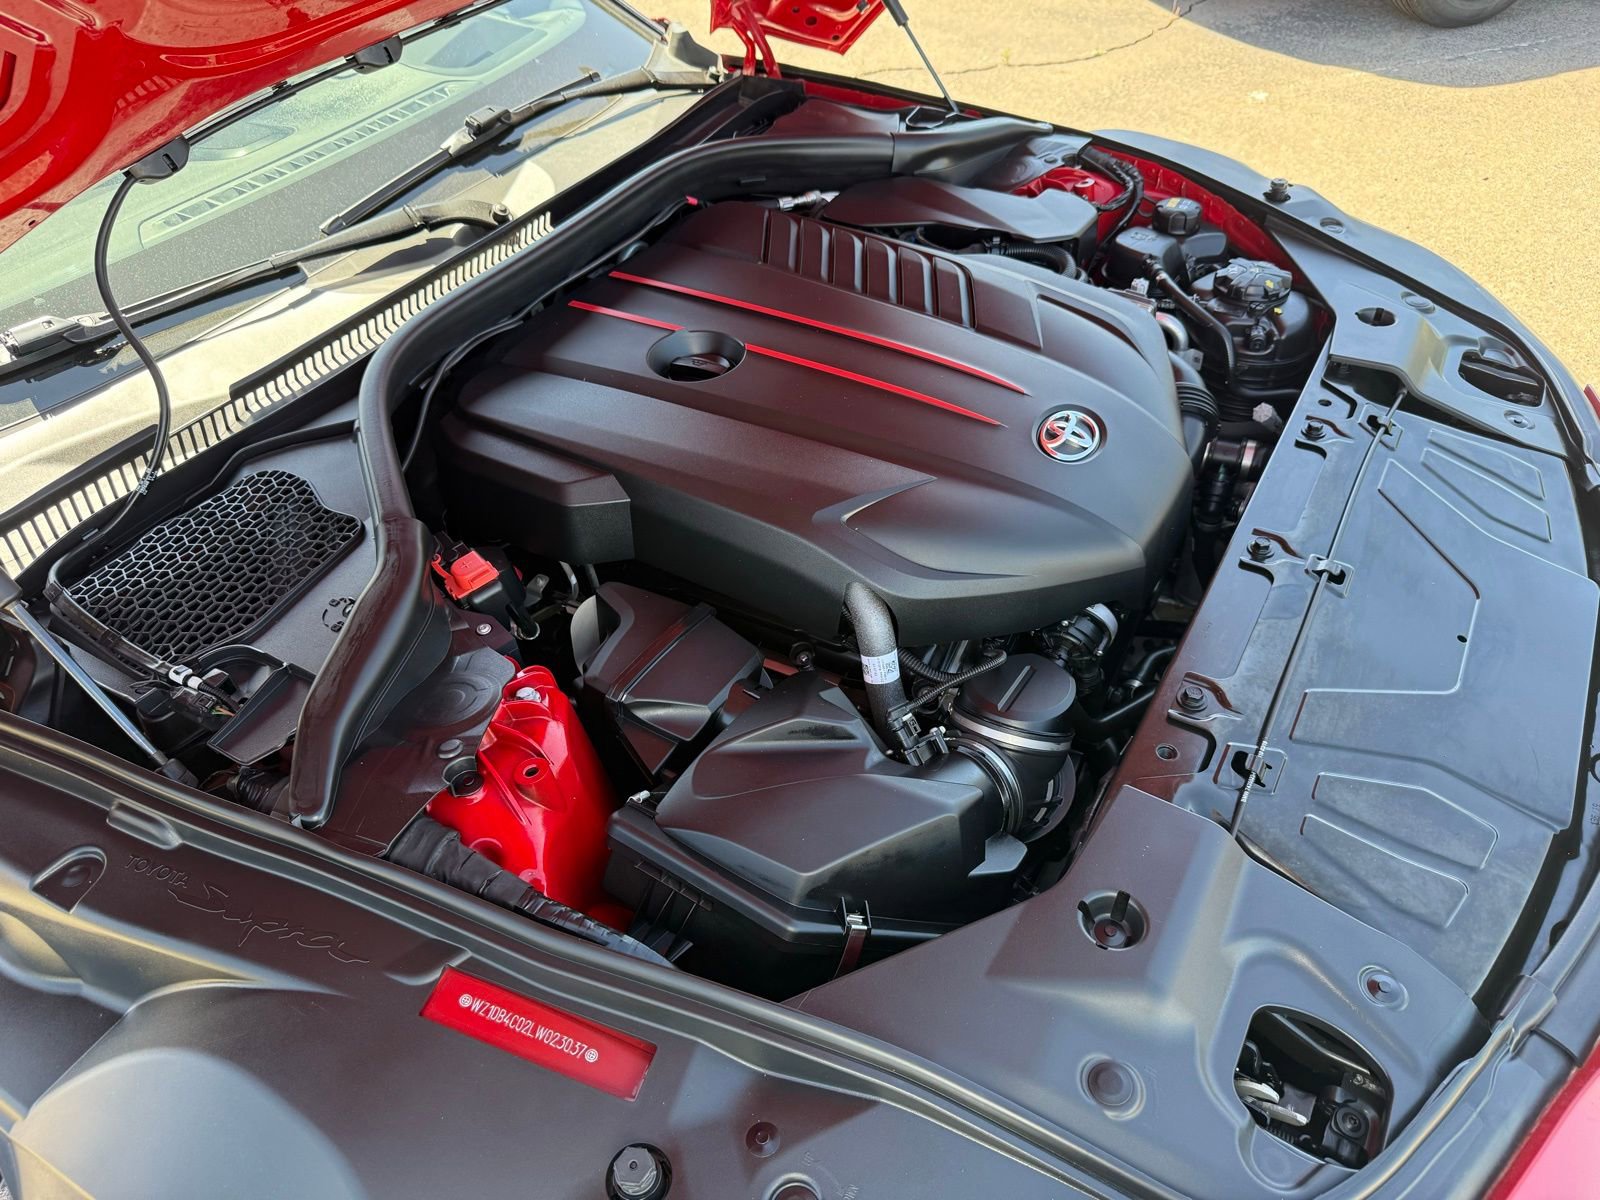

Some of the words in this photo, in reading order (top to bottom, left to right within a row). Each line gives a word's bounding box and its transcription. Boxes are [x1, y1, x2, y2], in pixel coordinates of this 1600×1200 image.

[124, 854, 188, 889] TOYOTA
[167, 883, 370, 964] Supra
[470, 996, 588, 1060] WZ1DB4C02LW023037
